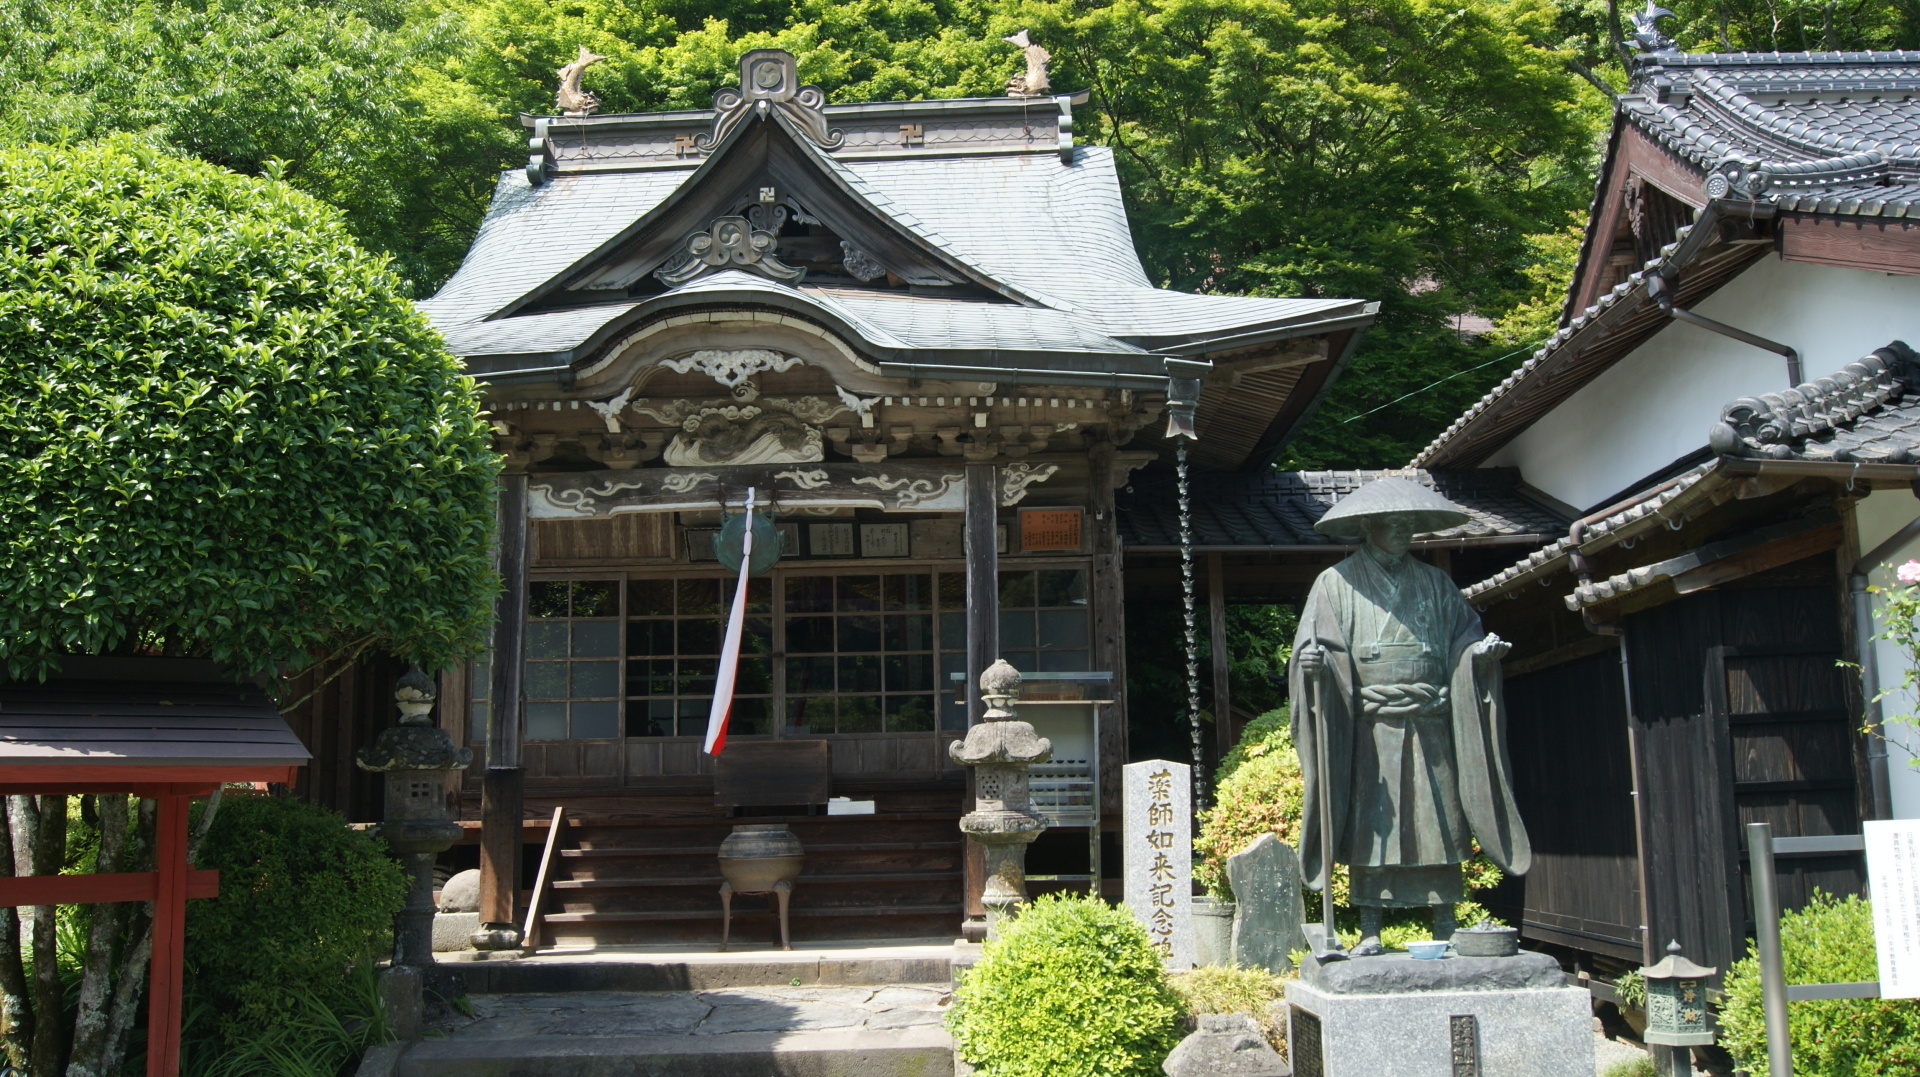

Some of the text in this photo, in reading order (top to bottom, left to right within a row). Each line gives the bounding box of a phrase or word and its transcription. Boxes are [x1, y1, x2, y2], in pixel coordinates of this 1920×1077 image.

[1146, 768, 1177, 964] 薬師如来記念碑
